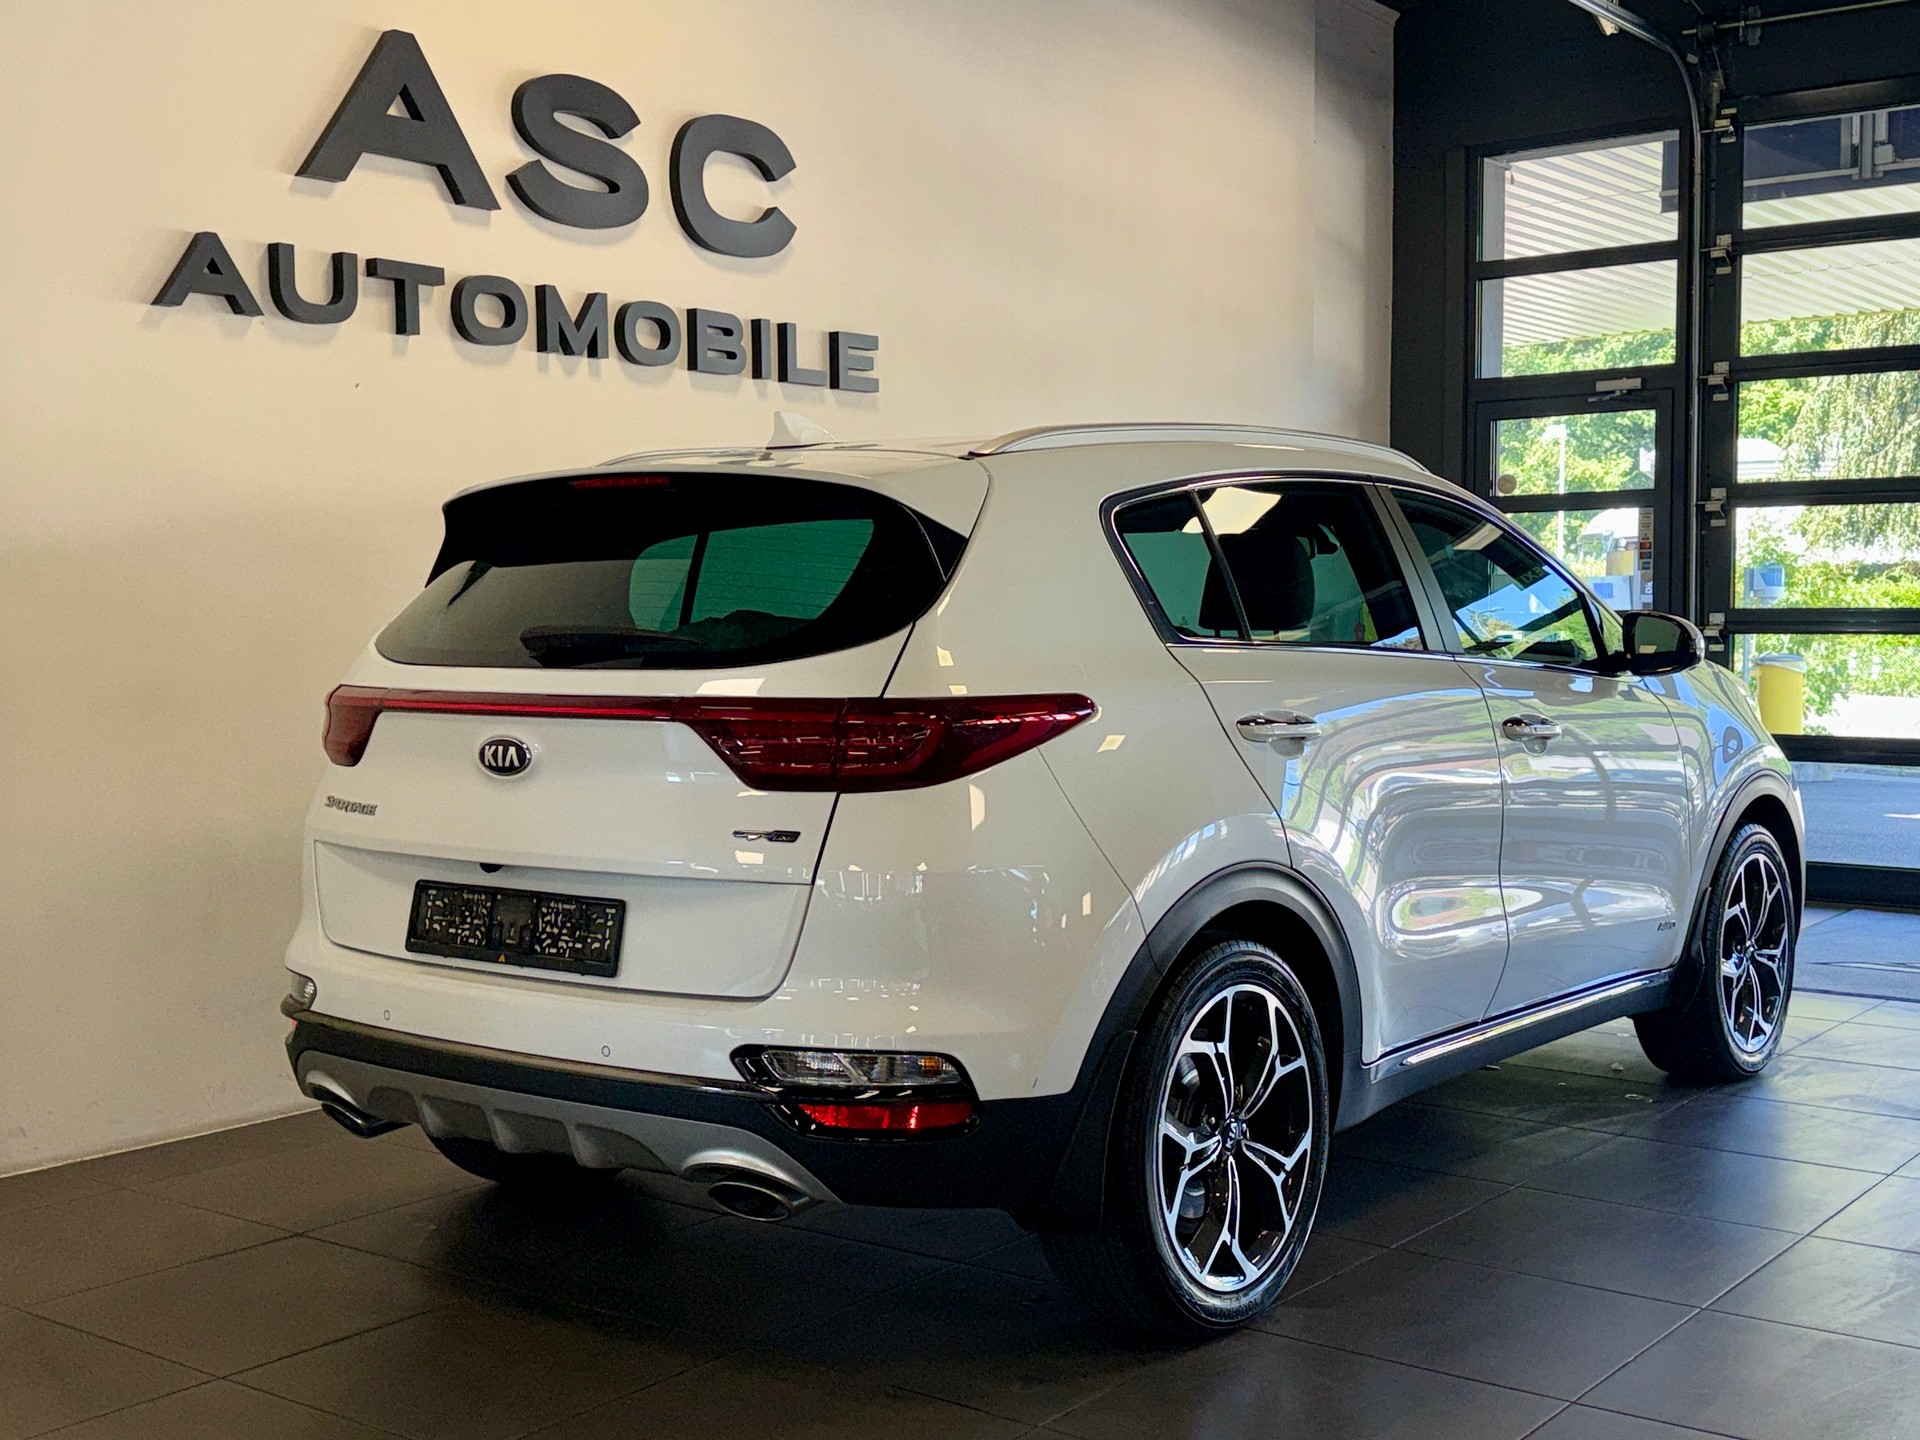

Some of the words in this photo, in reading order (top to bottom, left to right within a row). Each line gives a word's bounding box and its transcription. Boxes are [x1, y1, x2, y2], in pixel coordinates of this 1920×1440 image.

[295, 29, 798, 258] ASC
[151, 231, 879, 393] AUTOMOBILE
[484, 745, 521, 767] KIA
